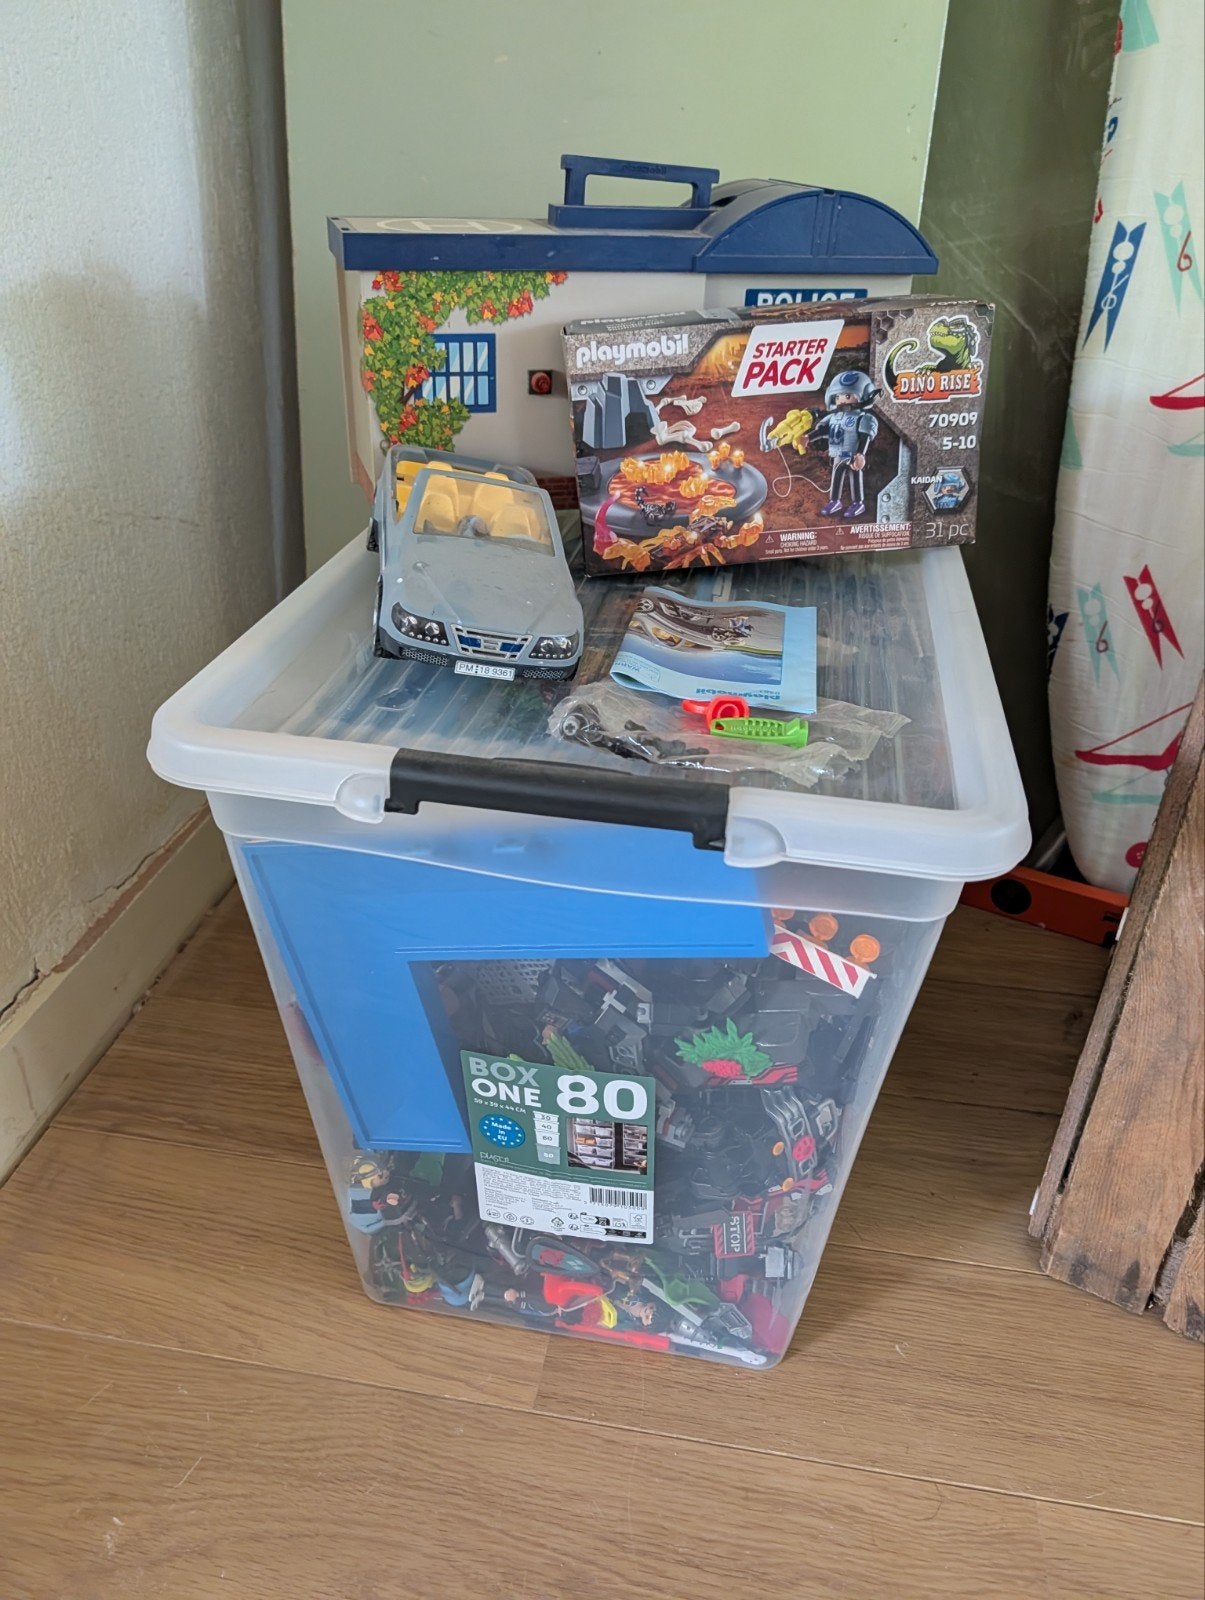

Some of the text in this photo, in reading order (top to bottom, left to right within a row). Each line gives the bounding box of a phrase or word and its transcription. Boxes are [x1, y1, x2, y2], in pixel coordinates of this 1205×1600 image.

[576, 333, 689, 368] playmobil
[753, 338, 828, 359] STARTER
[743, 357, 822, 389] PACK
[900, 373, 971, 393] DINO RISE
[929, 411, 978, 428] 70909
[942, 435, 977, 450] 5-10
[911, 474, 943, 485] KAIDAN
[780, 531, 818, 542] WARNING:
[850, 523, 912, 534] AVERTISSEMENT:
[925, 521, 969, 539] 31 pc
[459, 663, 474, 672] PM
[491, 668, 513, 677] 9361
[469, 1057, 540, 1087] BOX
[471, 1078, 542, 1108] ONE
[556, 1075, 648, 1120] 80
[491, 1121, 512, 1131] Made
[729, 1215, 741, 1253] STOP
